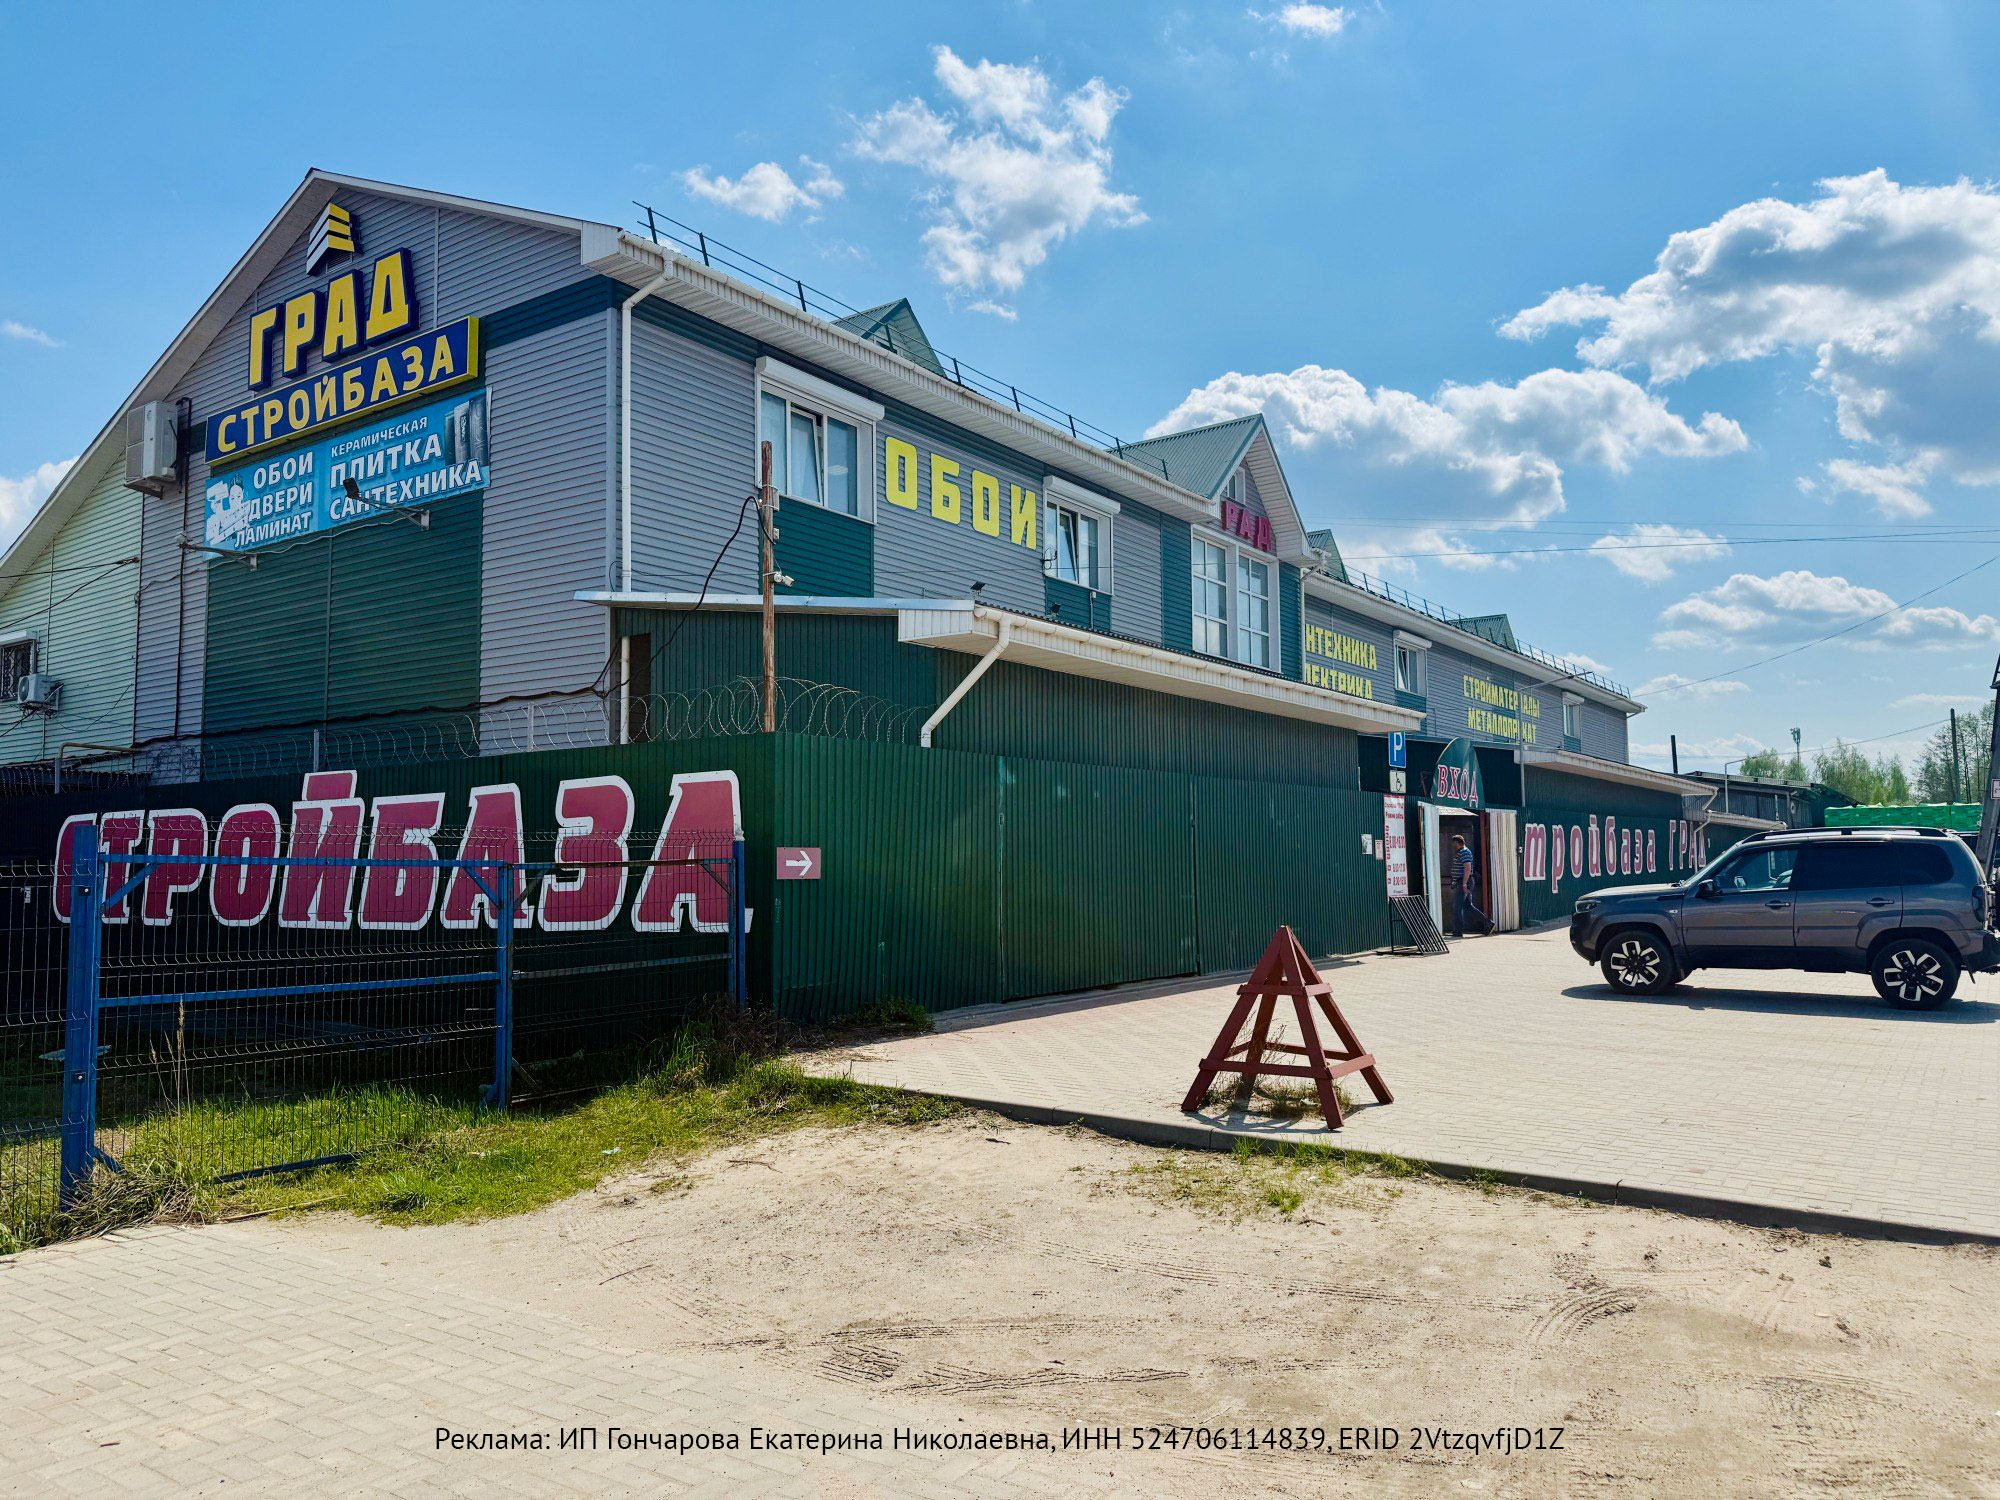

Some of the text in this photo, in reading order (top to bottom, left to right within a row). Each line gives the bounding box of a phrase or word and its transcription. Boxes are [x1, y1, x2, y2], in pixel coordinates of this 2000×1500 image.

[248, 248, 417, 391] ГРАД
[217, 334, 455, 453] СТРОЙБАЗА
[330, 433, 442, 489] ПЛИТКА
[331, 416, 428, 457] КЕРАМИЧЕСКАЯ
[253, 451, 314, 489] ОБОИ
[329, 460, 482, 520] САНТЕХНИКА
[885, 436, 1037, 550] ОБОИ
[248, 482, 313, 523] ДВЕРИ
[235, 512, 312, 548] ЛАМИНАТ
[1437, 764, 1479, 808] ВХОД
